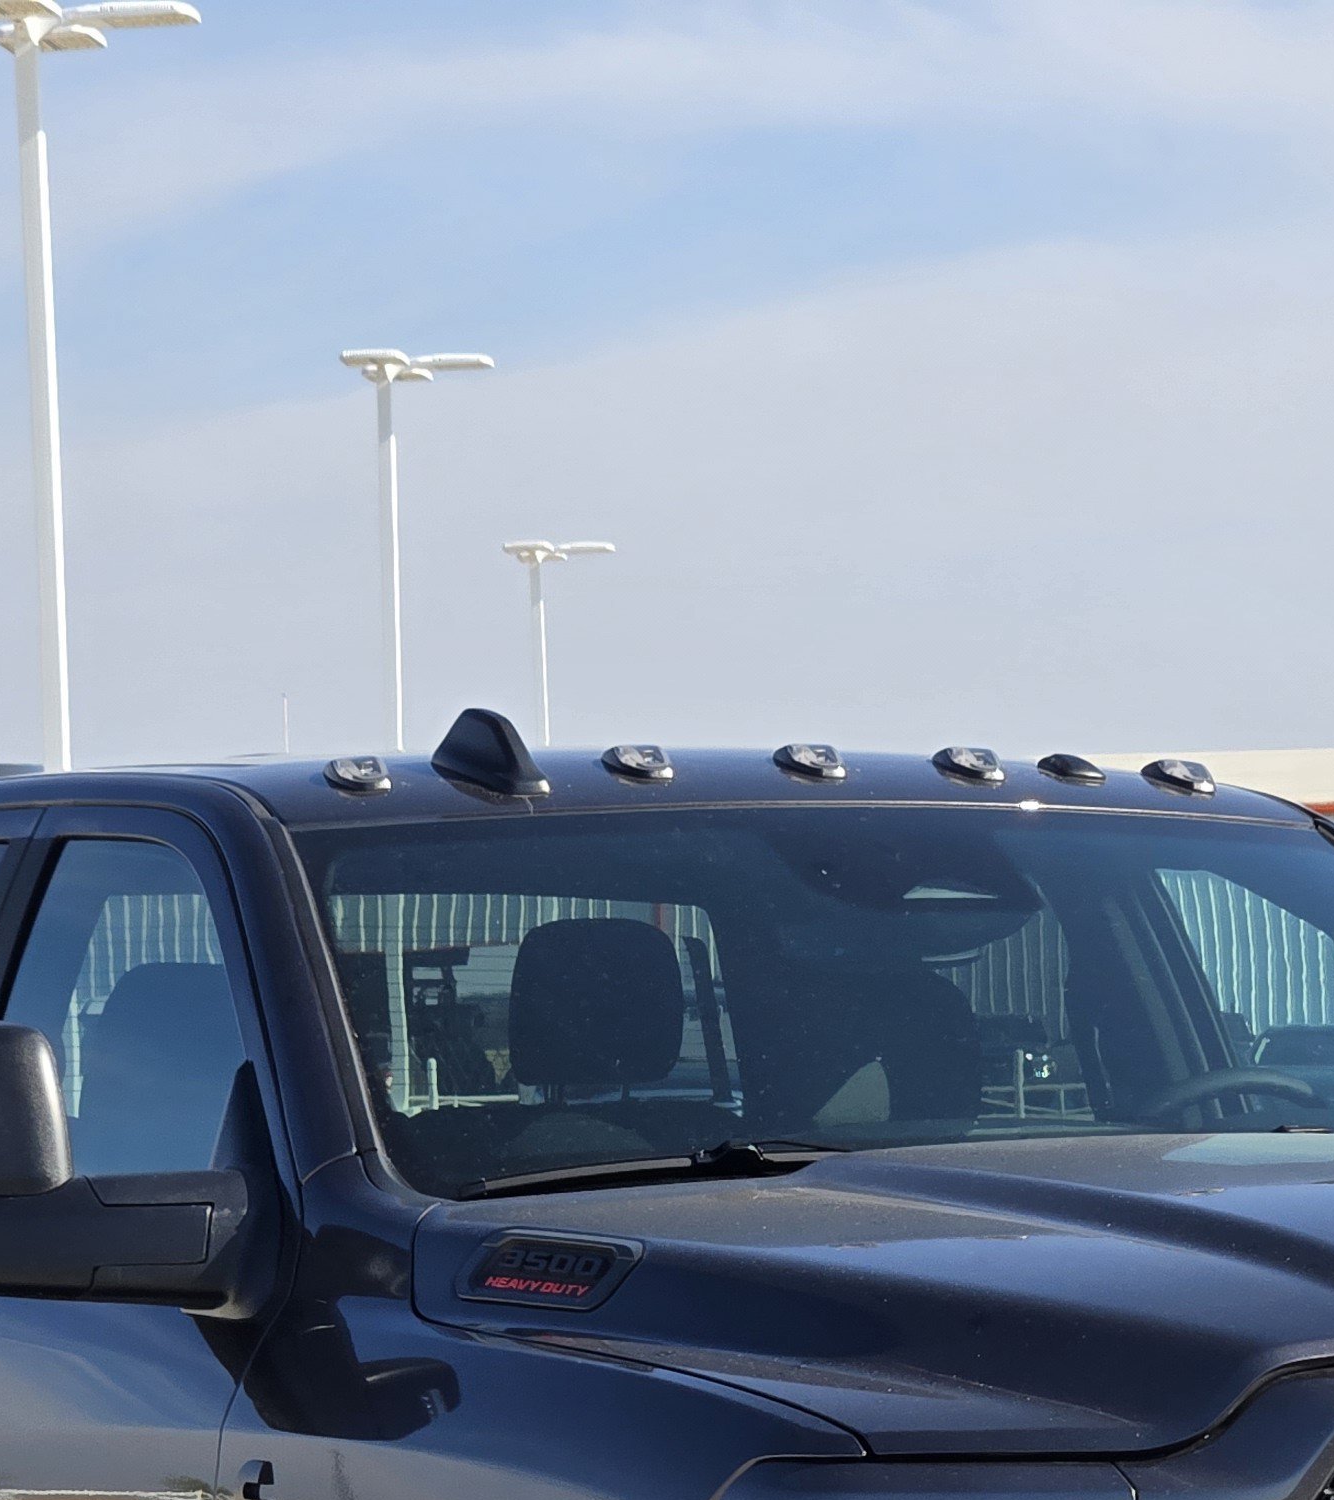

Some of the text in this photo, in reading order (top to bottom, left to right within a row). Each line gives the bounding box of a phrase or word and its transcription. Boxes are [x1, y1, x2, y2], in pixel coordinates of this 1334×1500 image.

[497, 1250, 604, 1276] 3500
[485, 1276, 590, 1297] HEAVY DUTY
